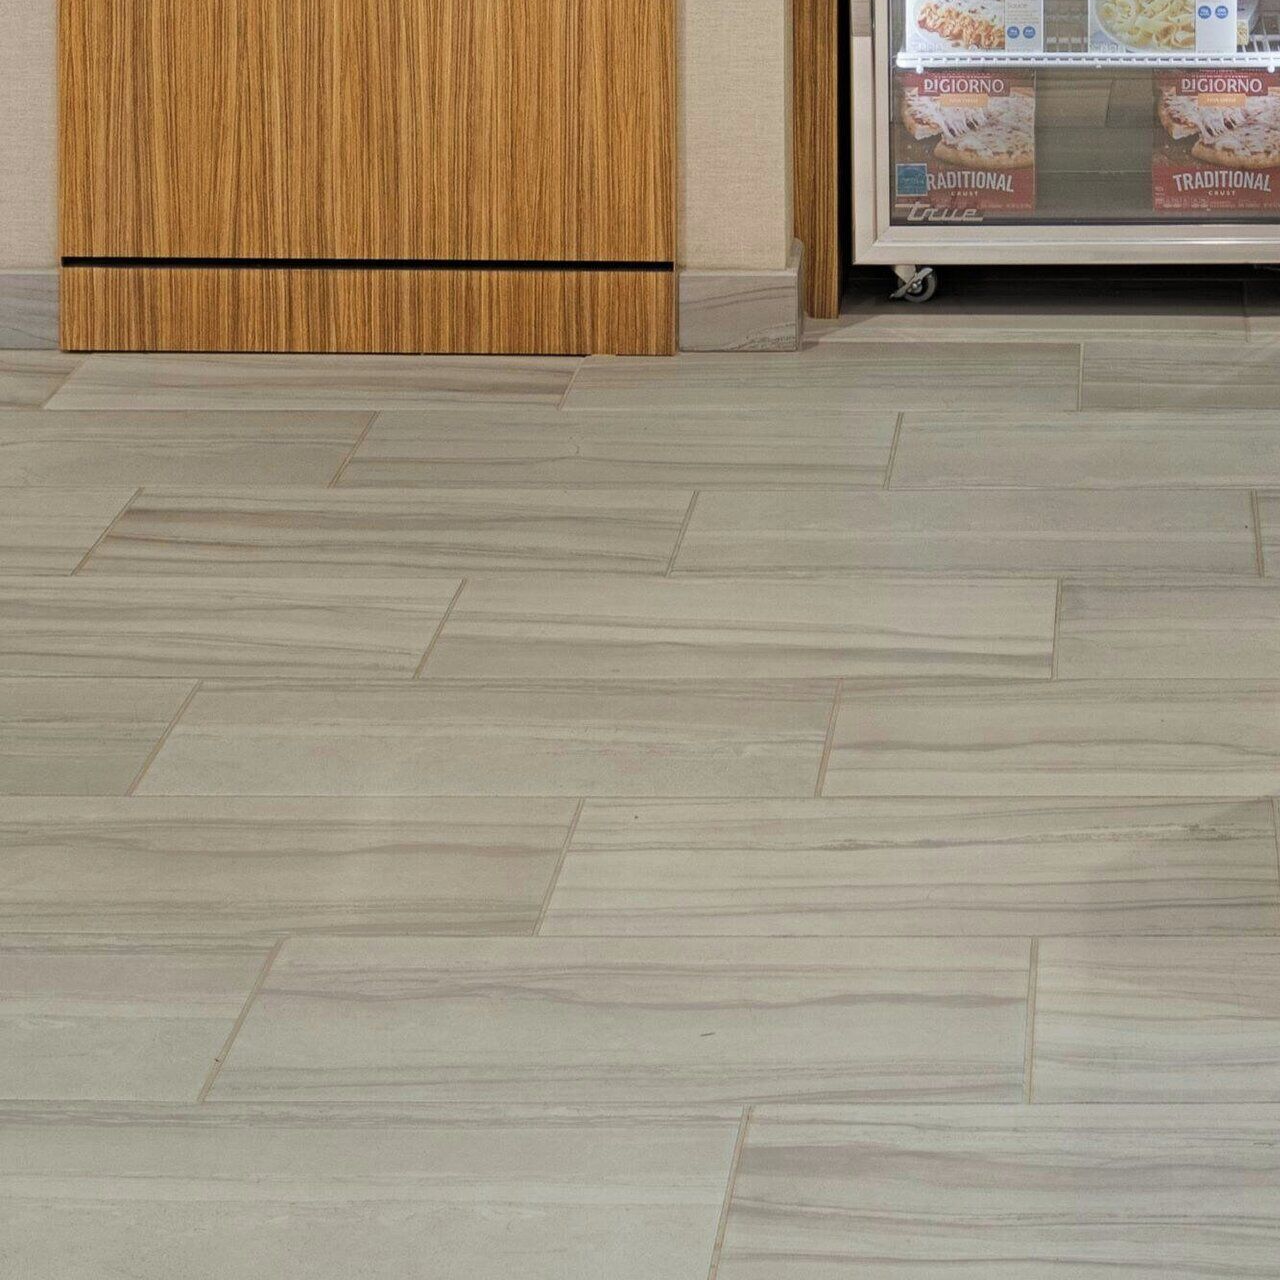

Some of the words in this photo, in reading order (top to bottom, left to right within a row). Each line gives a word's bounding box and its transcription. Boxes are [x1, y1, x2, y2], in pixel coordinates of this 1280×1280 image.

[923, 79, 1004, 93] DIGIORNO
[1181, 78, 1263, 93] DIGIORNO
[927, 170, 1014, 193] RADITIONAL
[1172, 170, 1272, 193] TRADITIONAL
[895, 202, 984, 222] true
